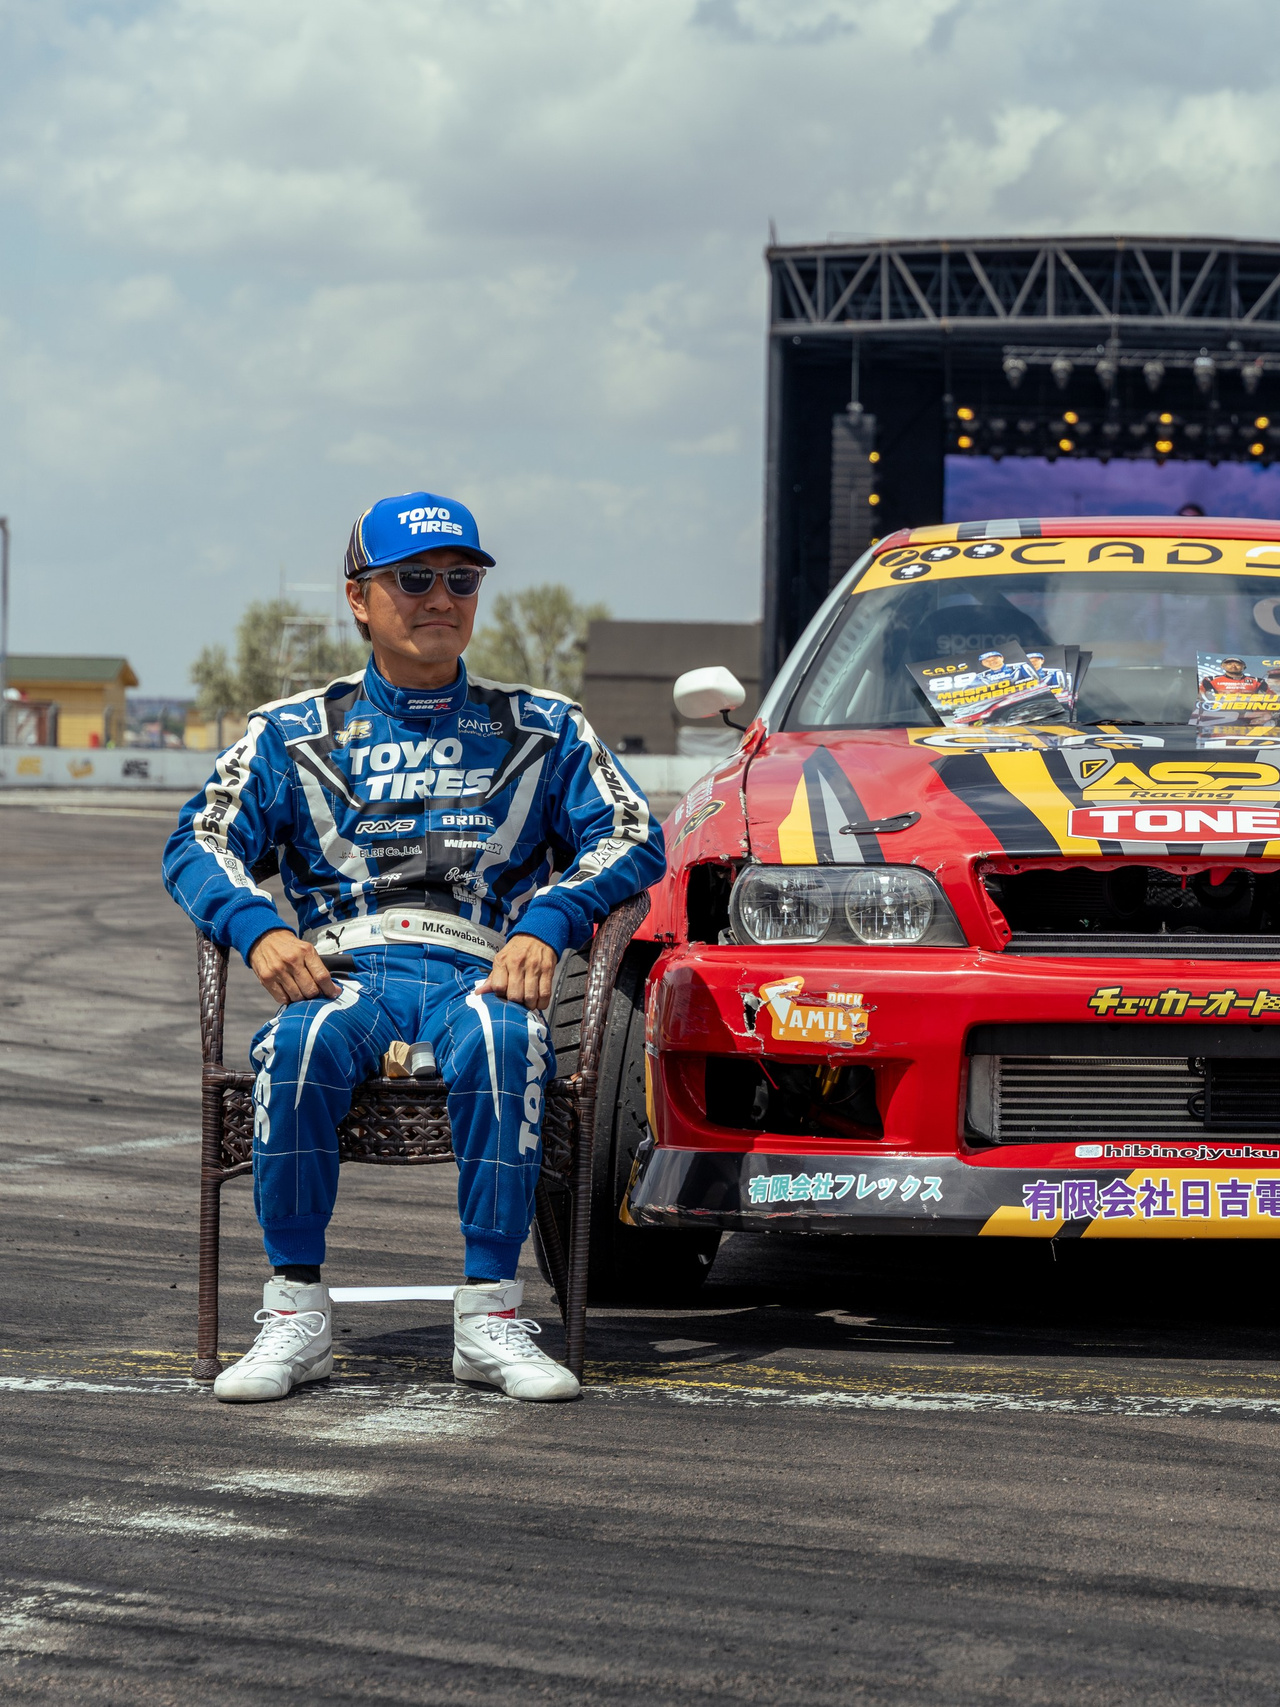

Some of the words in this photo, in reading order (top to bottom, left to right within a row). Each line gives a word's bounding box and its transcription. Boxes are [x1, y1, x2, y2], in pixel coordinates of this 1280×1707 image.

[398, 507, 450, 525] TOYO
[408, 520, 463, 536] TIRES
[929, 672, 977, 692] 88
[937, 680, 1011, 700] MASATO
[940, 679, 1040, 707] KAWABATA
[458, 717, 503, 733] KANTO
[350, 737, 463, 775] TOYO
[366, 767, 495, 800] TIRES
[1129, 790, 1235, 800] Racing
[355, 819, 416, 834] RAYS
[442, 814, 495, 828] BRIDE
[1089, 810, 1280, 835] TONE
[422, 921, 486, 946] M.Kawabata
[1104, 1144, 1280, 1161] hibinojyuku
[748, 1173, 944, 1203] 有限会社フレックス
